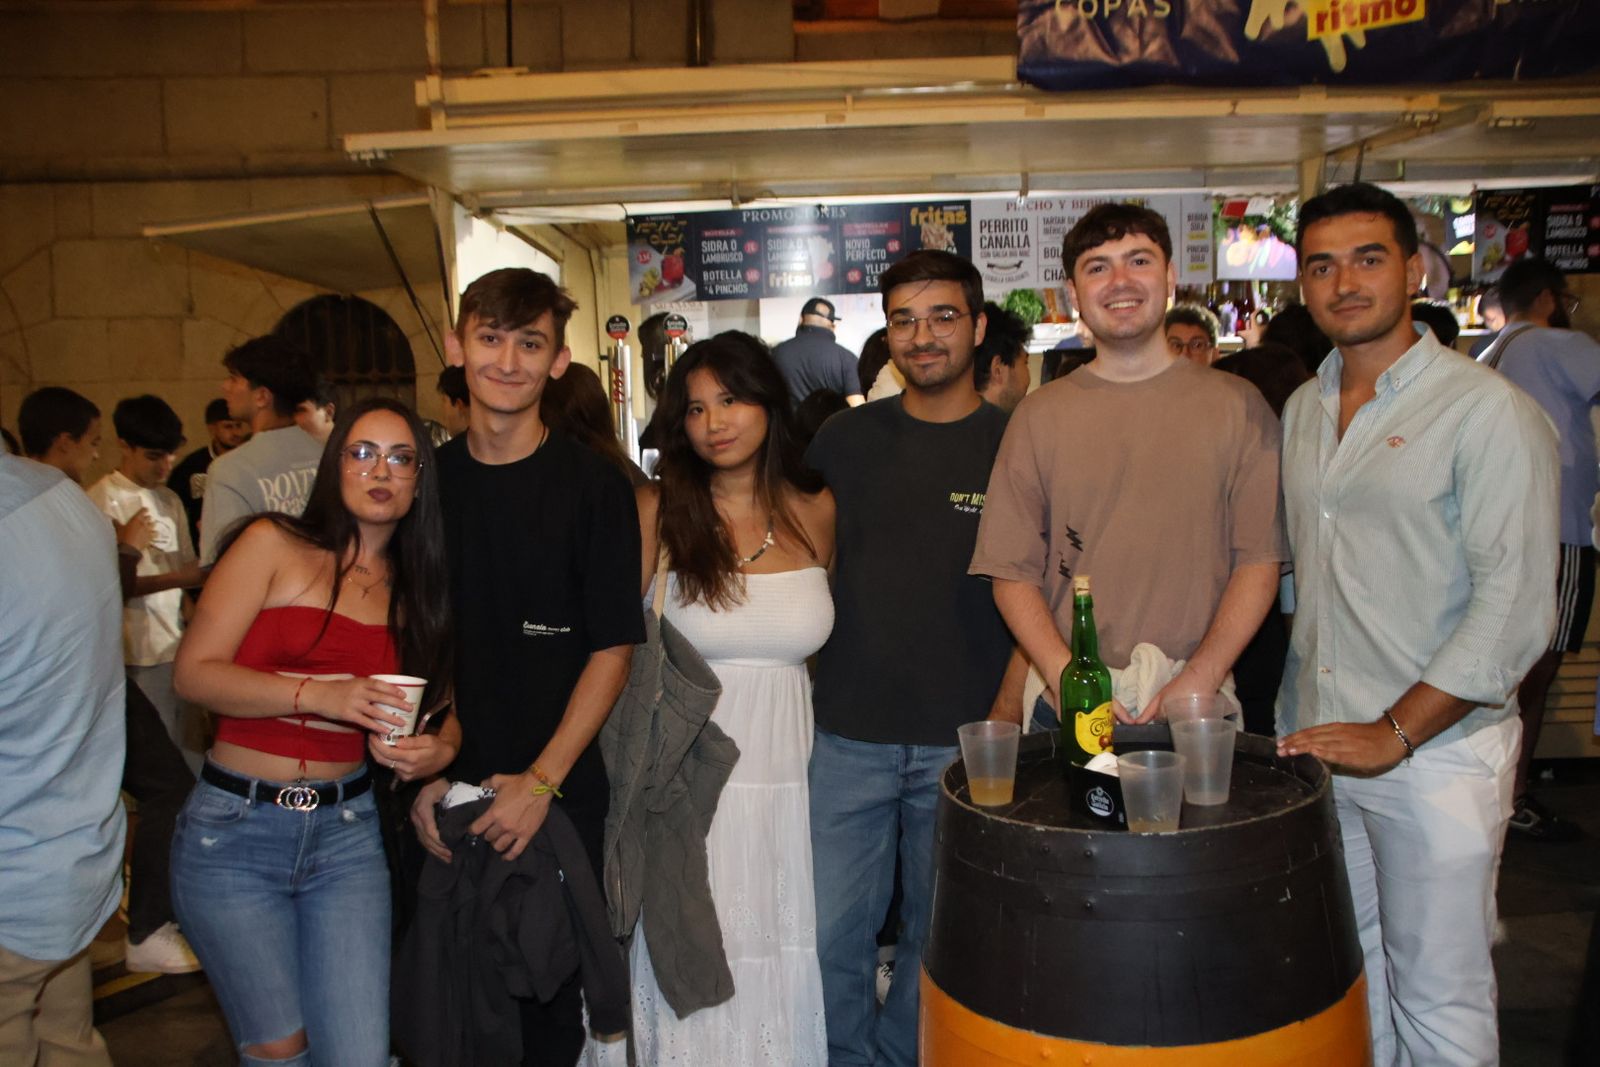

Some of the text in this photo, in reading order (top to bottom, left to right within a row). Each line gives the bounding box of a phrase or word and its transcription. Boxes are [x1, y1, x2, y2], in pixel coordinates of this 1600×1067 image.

[1055, 0, 1171, 19] COPAS
[1316, 0, 1417, 33] ritmo
[1006, 200, 1052, 211] PICHO
[1059, 199, 1066, 209] Y
[910, 205, 967, 226] fritas
[980, 218, 1028, 233] PERRITO
[701, 240, 728, 252] SIDRA
[845, 238, 870, 250] NOVIO
[980, 235, 1030, 249] CANALLA
[702, 252, 743, 264] LAMBRUSCO
[846, 249, 886, 262] PERFECTO
[1043, 247, 1062, 259] BOL
[865, 262, 892, 275] YLLER
[703, 270, 742, 282] BOTELLA
[1044, 269, 1065, 281] CHA
[715, 283, 748, 295] PINCHOS
